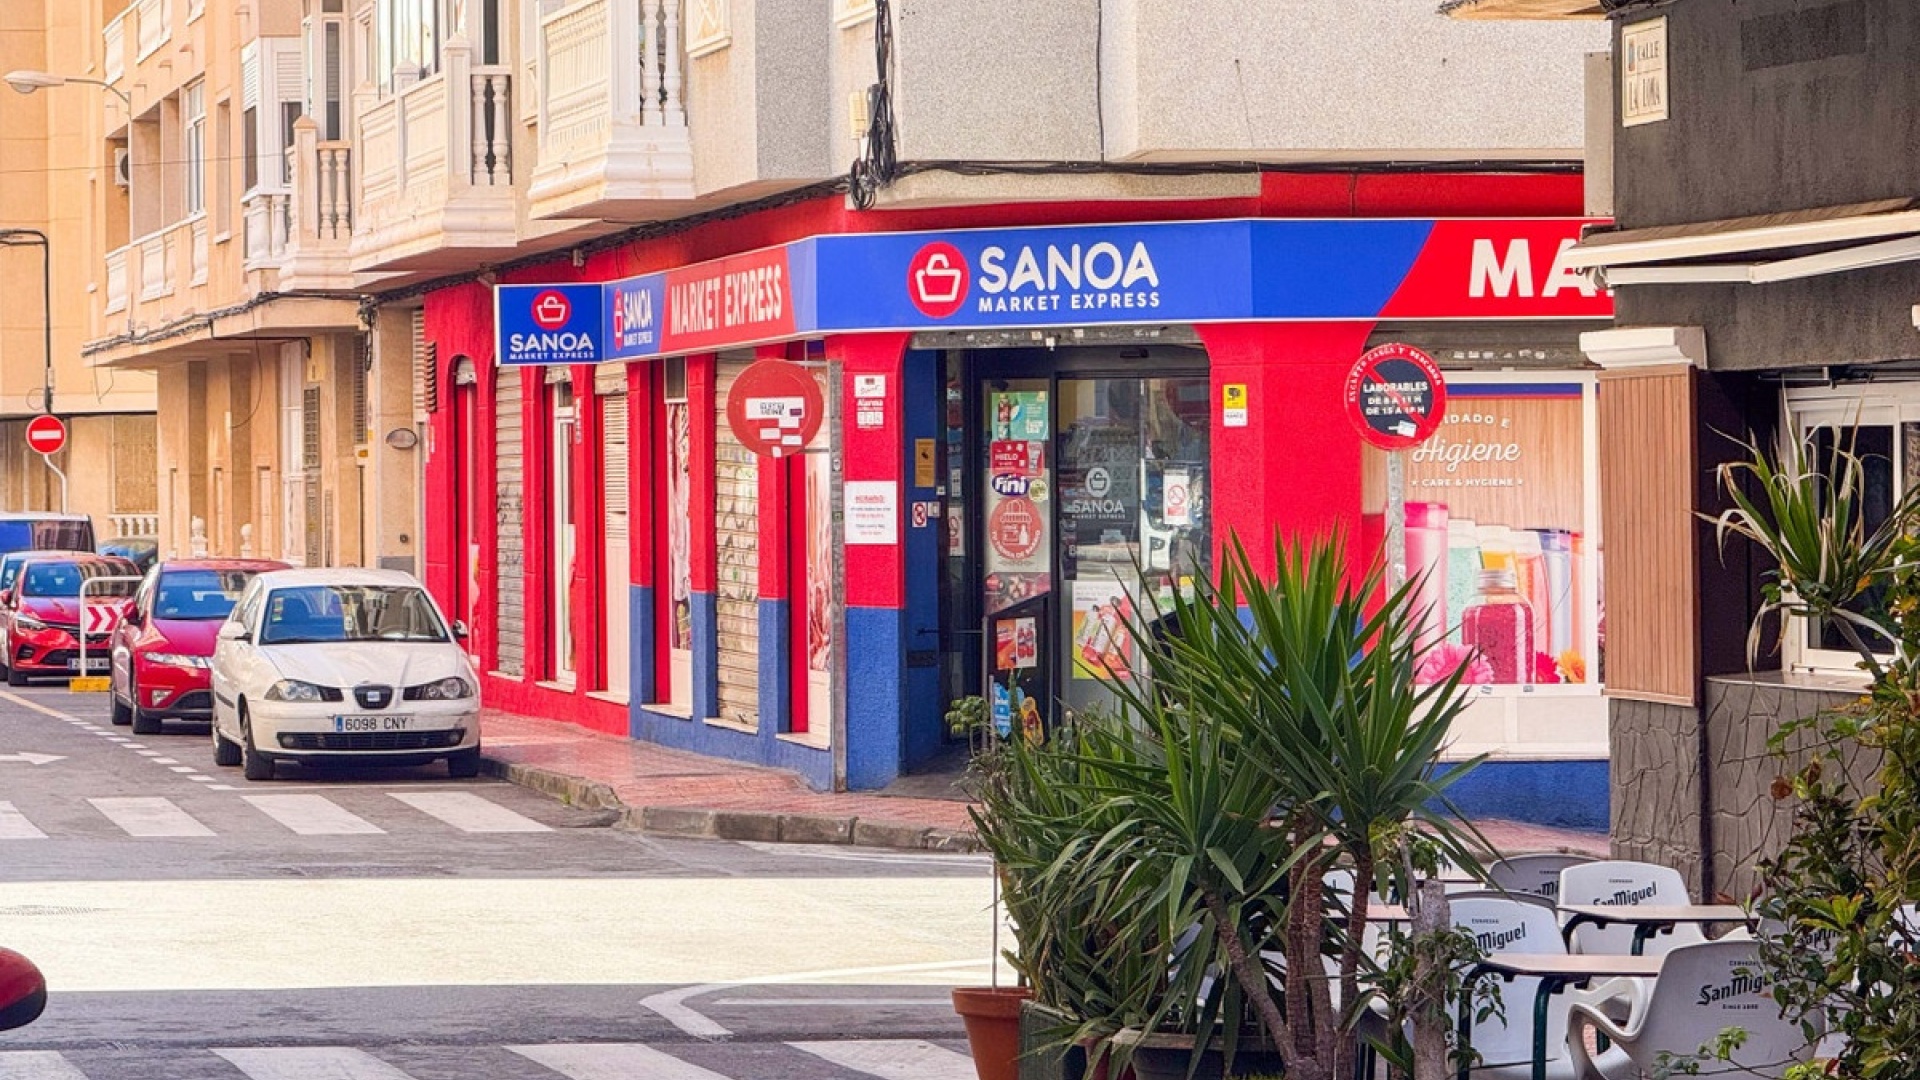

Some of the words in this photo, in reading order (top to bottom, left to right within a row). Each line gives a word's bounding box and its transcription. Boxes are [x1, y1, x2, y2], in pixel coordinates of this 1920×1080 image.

[979, 241, 1159, 293] SANOA
[1468, 238, 1614, 298] MA
[623, 288, 653, 331] SANOA
[670, 276, 721, 336] MARKET
[724, 264, 782, 328] EXPRESS
[978, 294, 1060, 313] MARKET
[1071, 291, 1160, 309] EXPRESS
[509, 331, 595, 352] SANOA
[508, 351, 549, 360] MARKET
[552, 350, 595, 359] EXPRESS
[1362, 381, 1429, 394] LABORABLES
[1444, 412, 1495, 425] IDADO
[1501, 417, 1511, 429] E
[1412, 433, 1522, 473] Higiene
[1421, 478, 1451, 487] CARE
[1465, 478, 1514, 487] HYGIENE
[1072, 499, 1126, 514] SANOA
[345, 717, 377, 731] 6098
[383, 716, 408, 730] CNY
